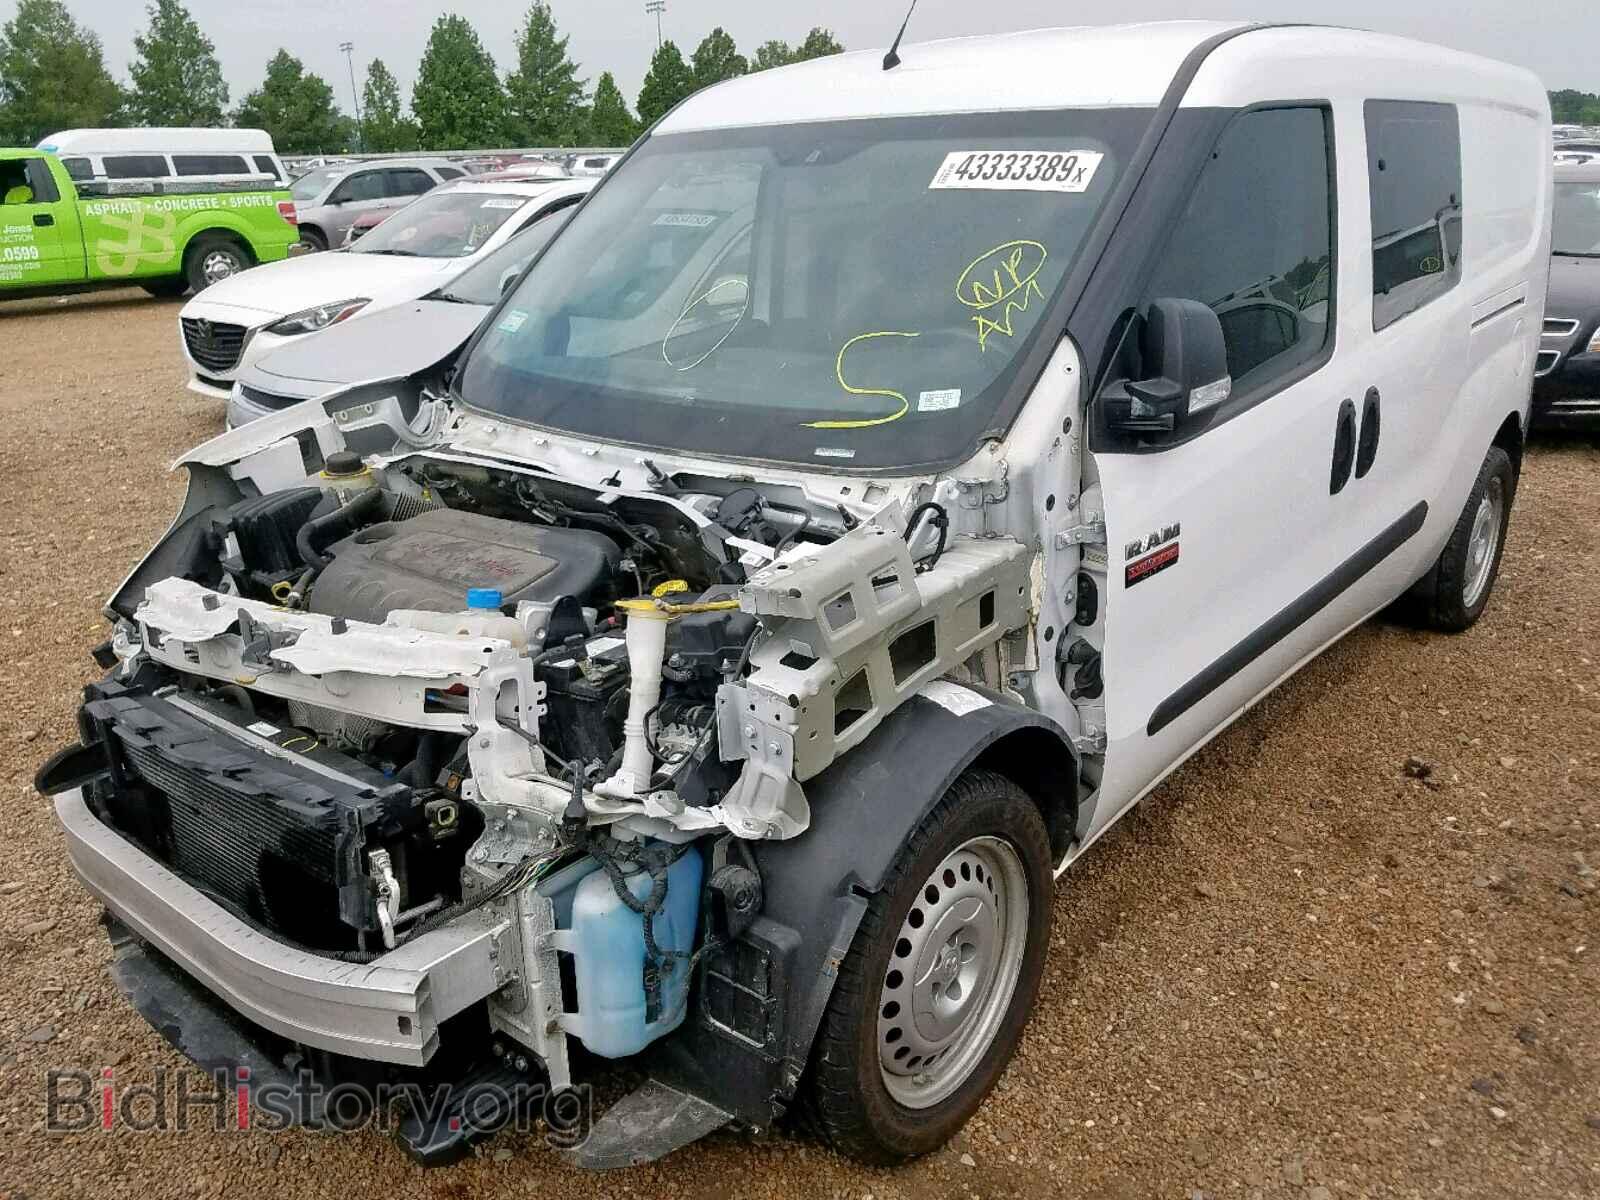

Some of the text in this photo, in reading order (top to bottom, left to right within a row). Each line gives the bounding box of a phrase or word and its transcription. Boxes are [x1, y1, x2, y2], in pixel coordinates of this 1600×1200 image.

[154, 197, 220, 212] CONCRETE
[230, 195, 273, 208] SPORTS
[1124, 522, 1181, 562] RAM
